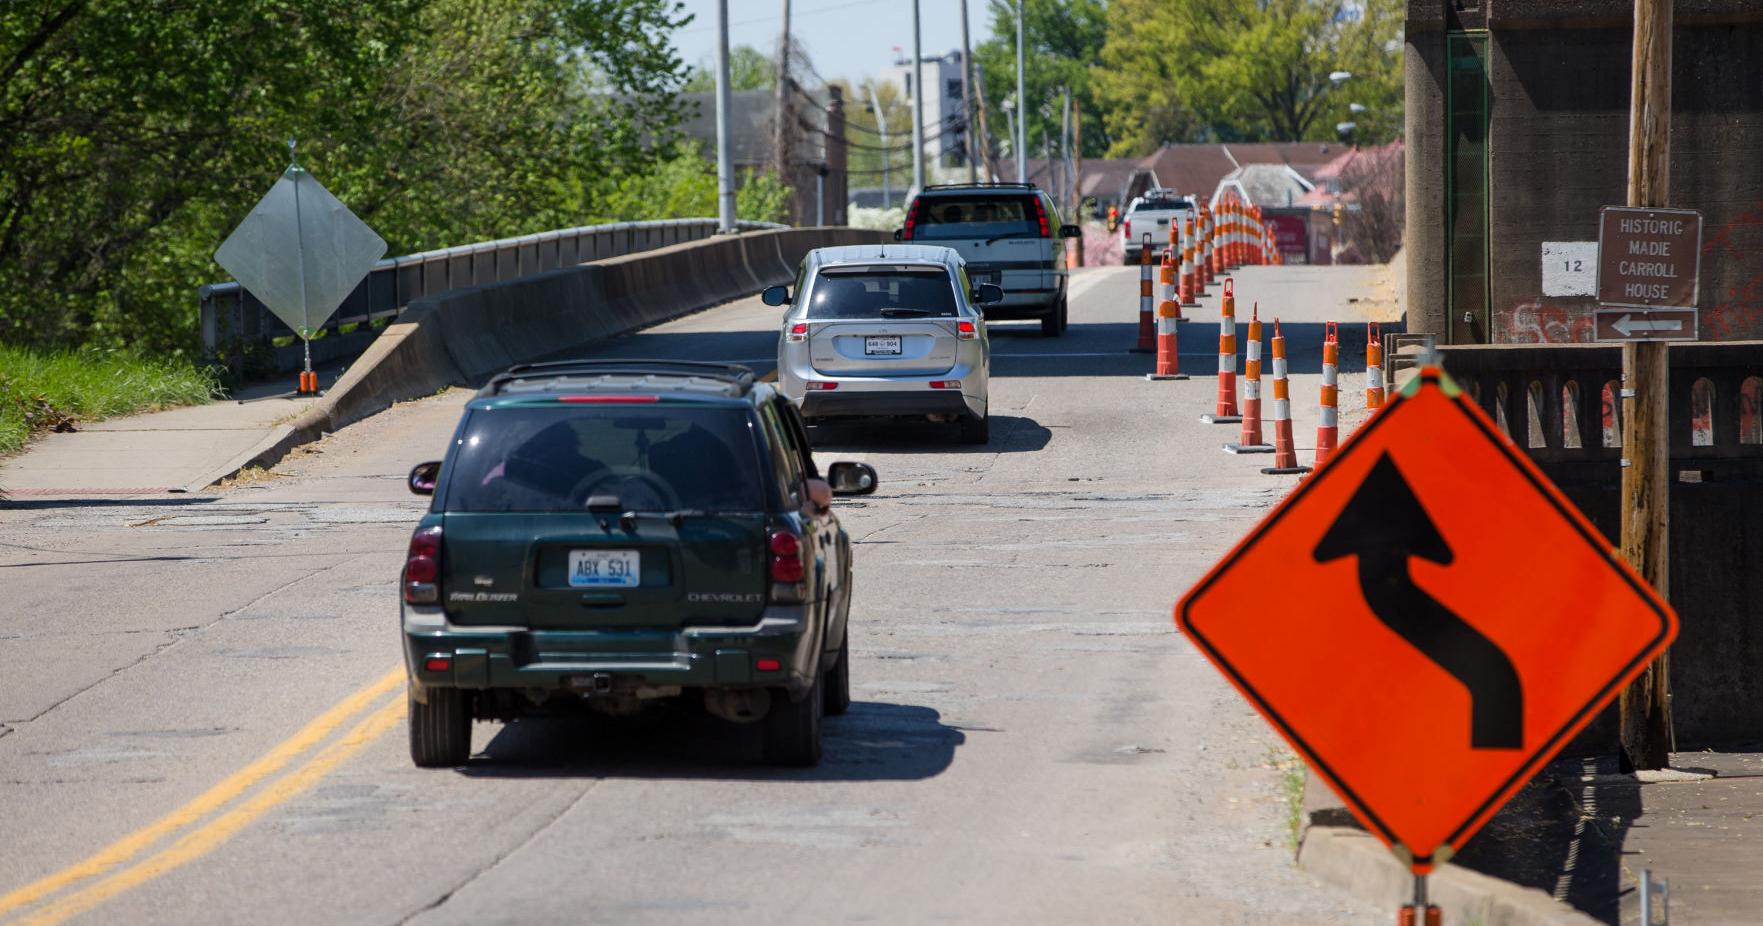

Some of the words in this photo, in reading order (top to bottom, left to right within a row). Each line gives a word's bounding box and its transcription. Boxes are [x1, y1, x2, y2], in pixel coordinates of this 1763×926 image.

[1620, 219, 1683, 235] HISTORIC
[1629, 240, 1671, 256] MADIE
[1564, 260, 1582, 272] 12
[1619, 261, 1678, 278] CARROLL
[1625, 283, 1670, 299] HOUSE
[576, 559, 599, 577] ABX
[608, 559, 631, 577] 531
[688, 593, 762, 602] CHEVROLET
